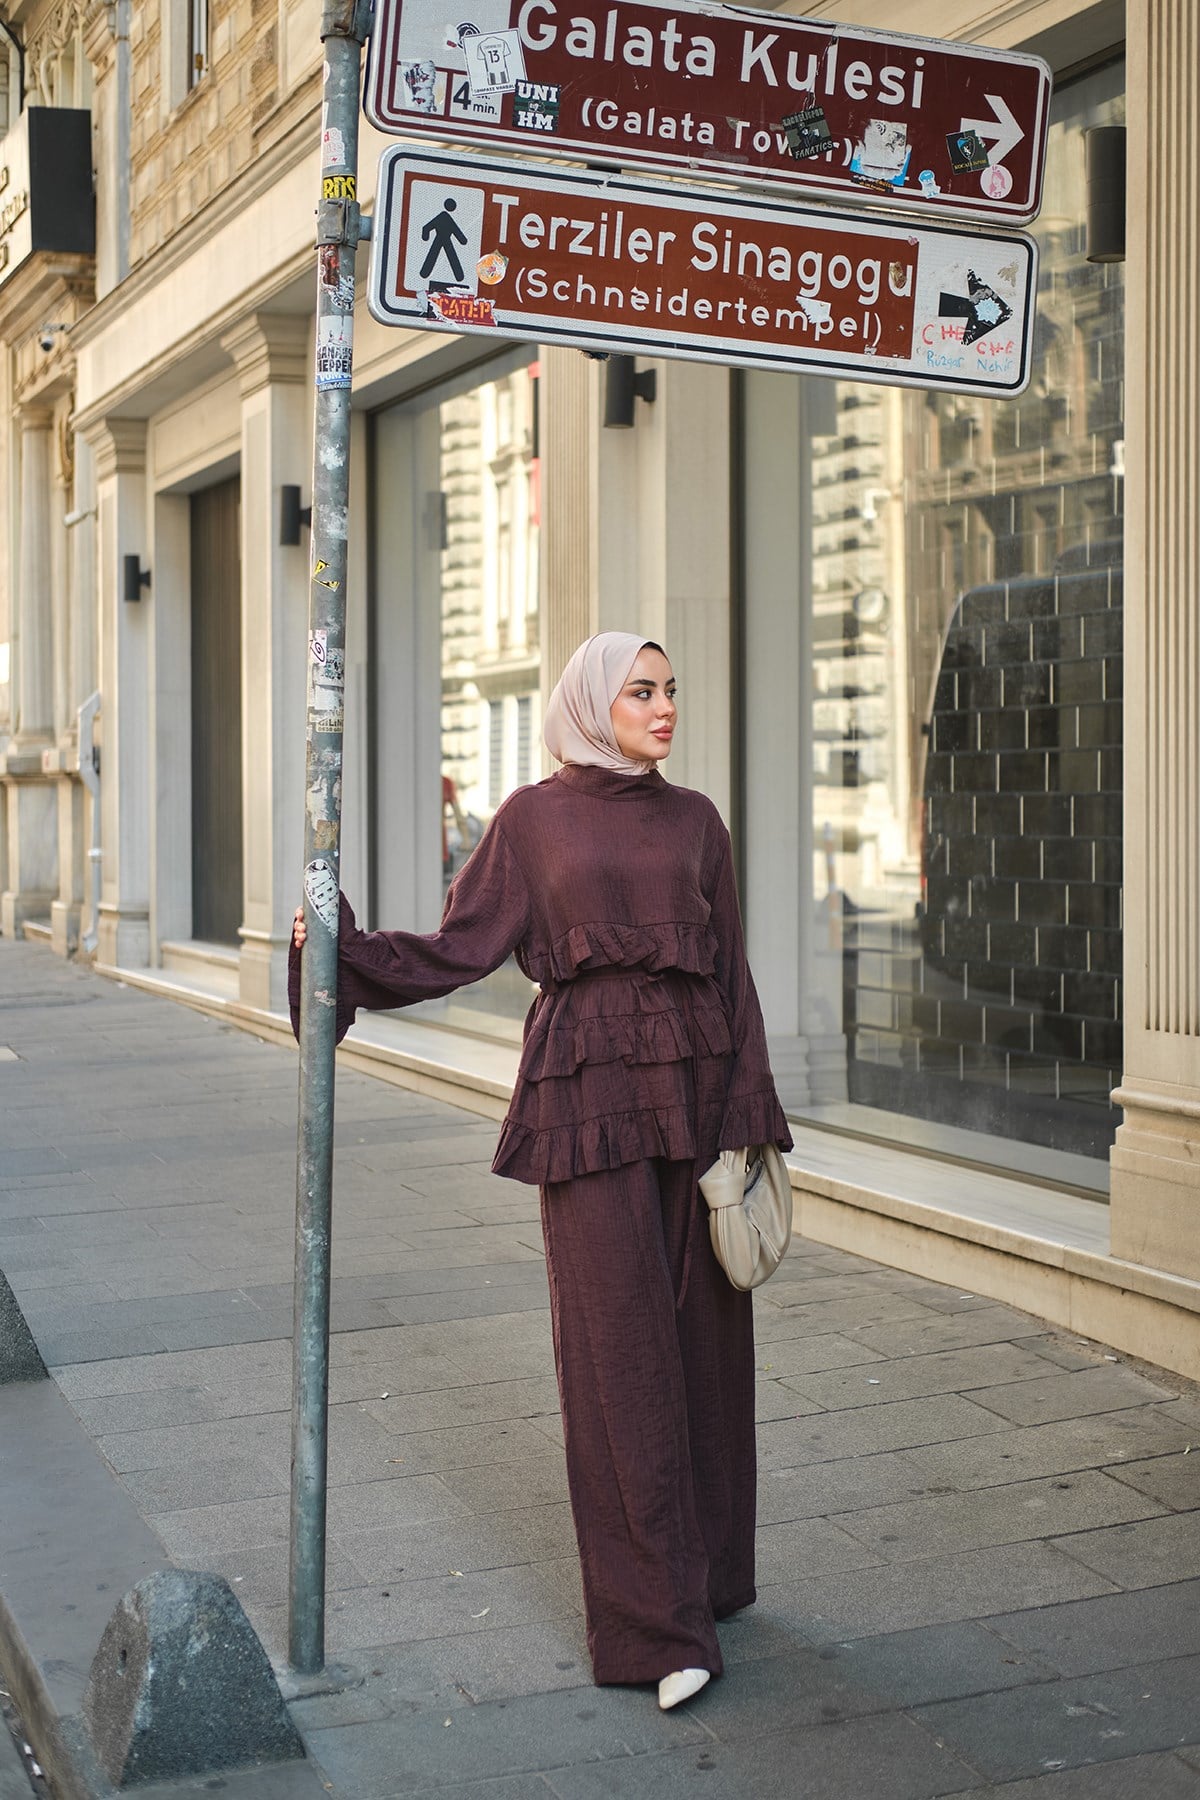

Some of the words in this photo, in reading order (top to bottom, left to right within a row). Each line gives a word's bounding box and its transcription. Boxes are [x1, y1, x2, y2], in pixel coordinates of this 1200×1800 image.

[488, 50, 500, 63] 13
[517, 0, 716, 77] Galata
[740, 30, 925, 109] Kulesi
[453, 81, 471, 110] 4
[473, 102, 497, 115] min.
[517, 82, 559, 103] UNI
[517, 111, 554, 130] HM
[582, 98, 715, 146] (Galata
[733, 121, 853, 166] Towr)
[795, 141, 833, 159] FANATICS
[492, 193, 677, 265] Terziler
[690, 222, 914, 306] Sinagogu
[515, 267, 882, 348] (Schneidertempel)
